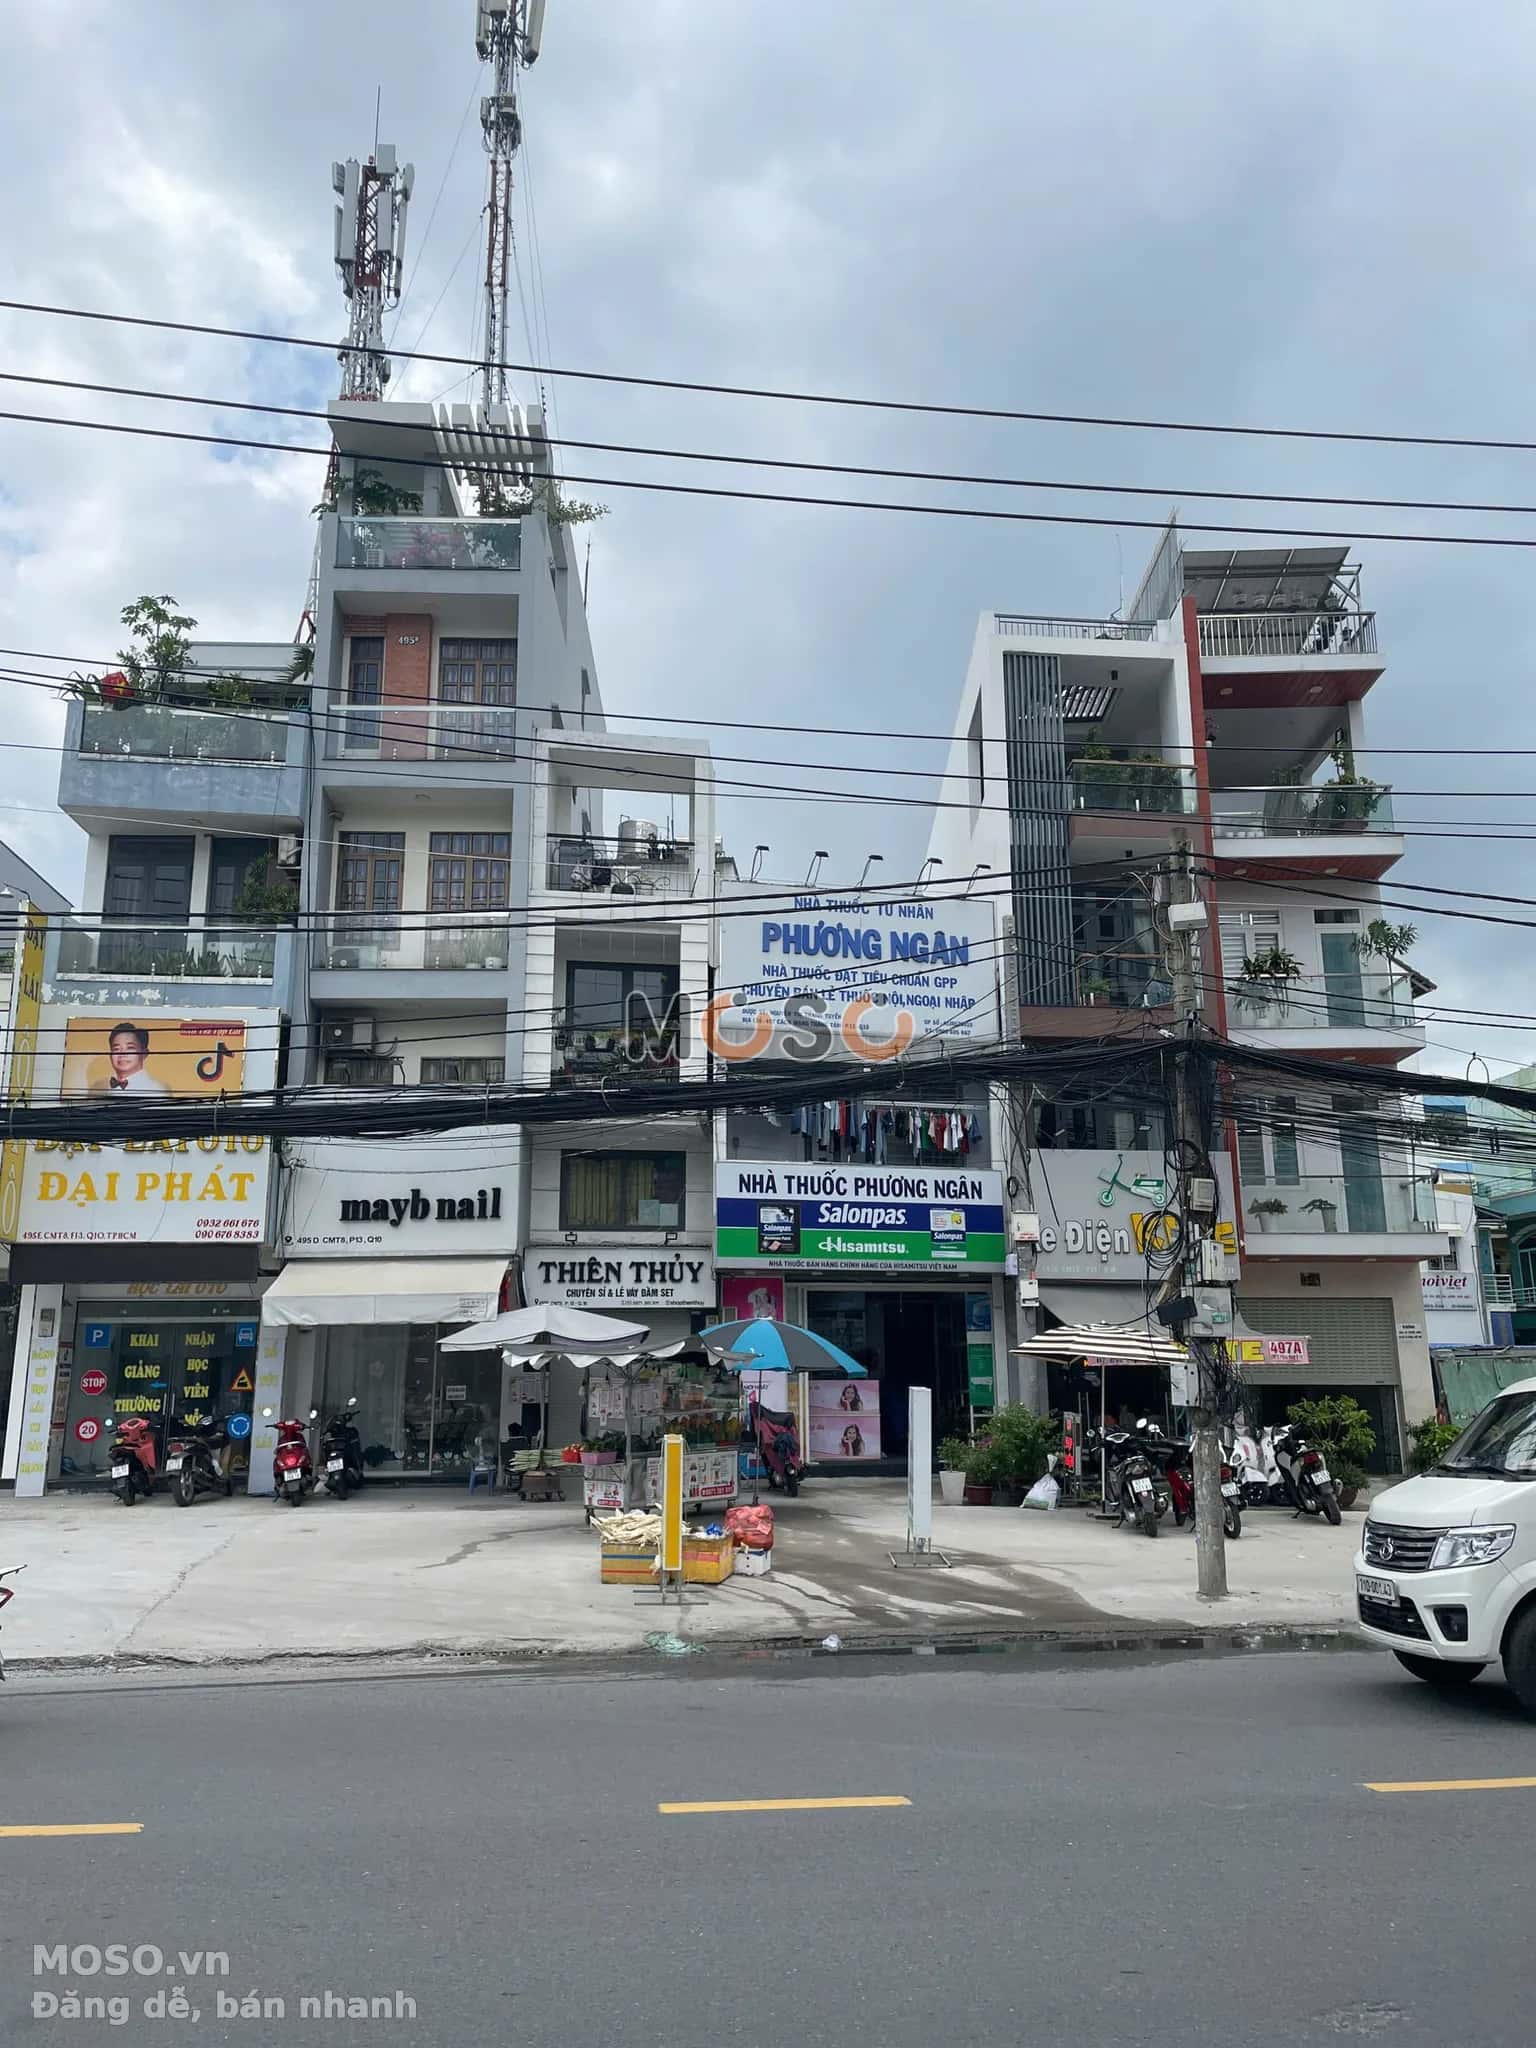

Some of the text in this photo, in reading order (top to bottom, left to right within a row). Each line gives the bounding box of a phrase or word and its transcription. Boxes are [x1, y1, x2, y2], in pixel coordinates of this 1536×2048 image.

[899, 904, 934, 920] NHÂN
[762, 920, 969, 967] PHƯƠNG NGÂN
[762, 964, 788, 978] NHÀ
[791, 965, 831, 981] THUỐC
[835, 970, 858, 985] ĐẠT
[934, 976, 958, 989] GPP
[742, 984, 790, 998] CHUYÊN
[38, 1164, 255, 1207] ĐẠI PHÁT
[739, 1169, 982, 1200] NHÀ THUỐC PHƯƠNG NGÂN
[339, 1187, 502, 1227] mayb nail
[818, 1203, 906, 1228] Salonpas
[818, 1237, 907, 1254] Hisamitsu
[1065, 1219, 1130, 1262] Điện
[538, 1253, 704, 1284] THIÊN THỦY
[566, 1287, 595, 1298] CHUYÊN
[660, 1288, 674, 1298] SET
[92, 1329, 104, 1342] P
[129, 1334, 159, 1347] KHAI
[185, 1331, 215, 1348] NHẬN
[1270, 1341, 1303, 1354] 497A
[124, 1360, 160, 1378] GIẢNG
[186, 1358, 209, 1373] HỌC
[82, 1378, 106, 1388] STOP
[183, 1382, 209, 1398] VIÊN
[82, 1425, 95, 1434] 20
